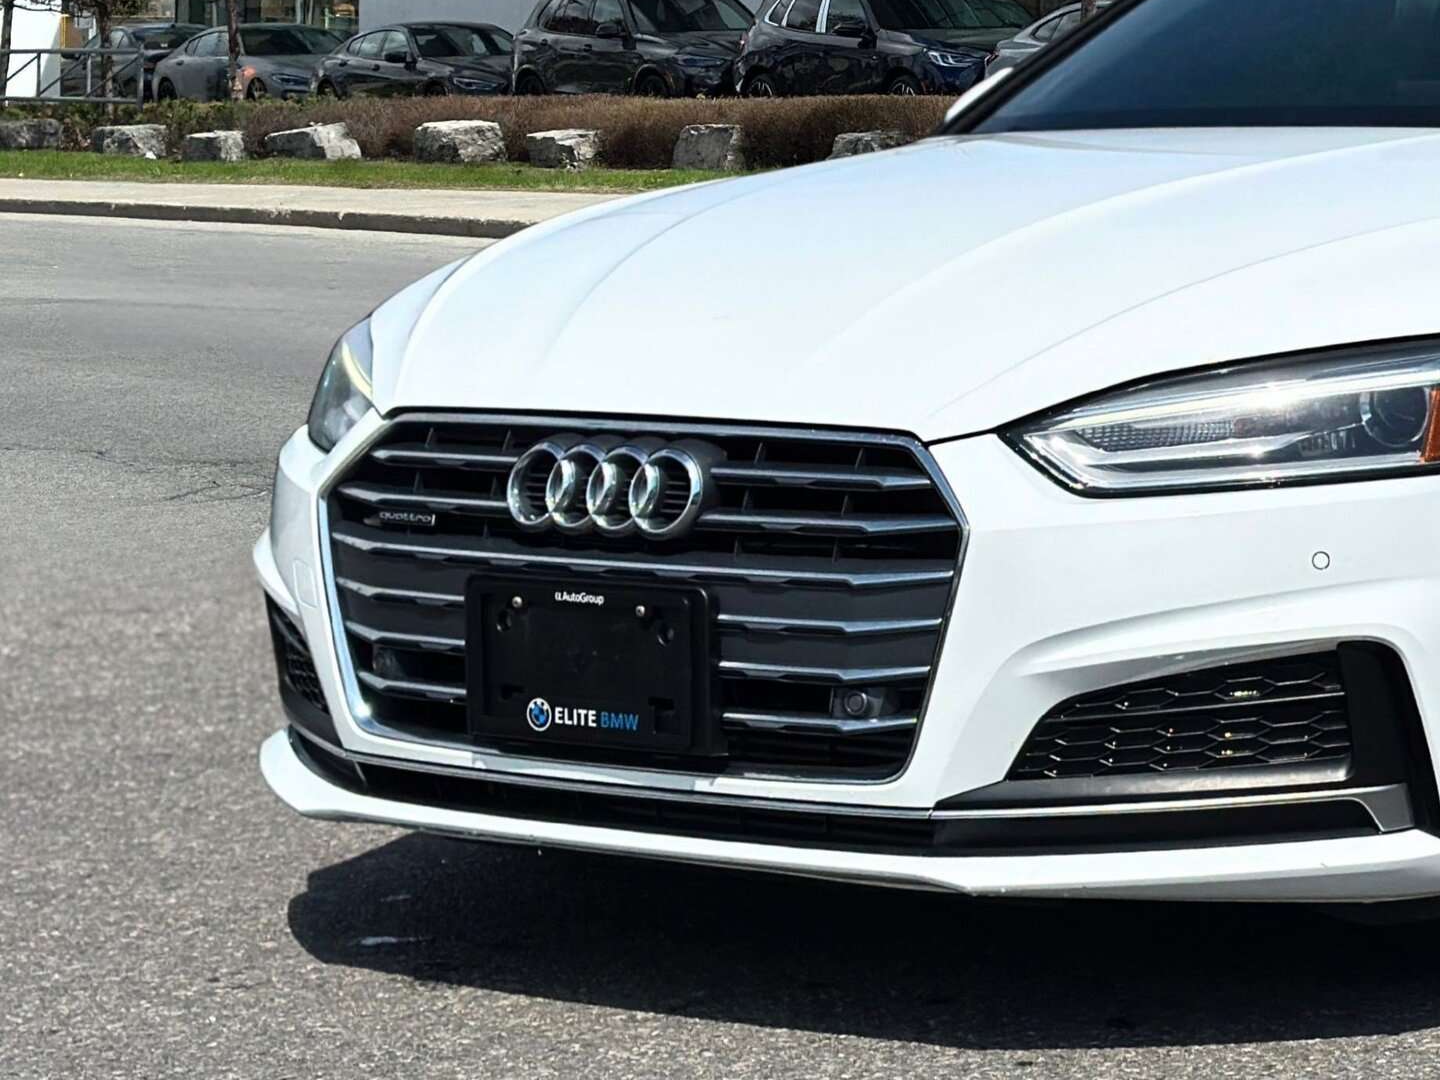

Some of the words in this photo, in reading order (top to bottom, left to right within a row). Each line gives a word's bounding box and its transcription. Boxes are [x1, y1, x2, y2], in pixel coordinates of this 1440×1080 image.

[380, 511, 431, 523] quattro
[554, 706, 597, 728] ELITE
[600, 710, 640, 731] BMW
